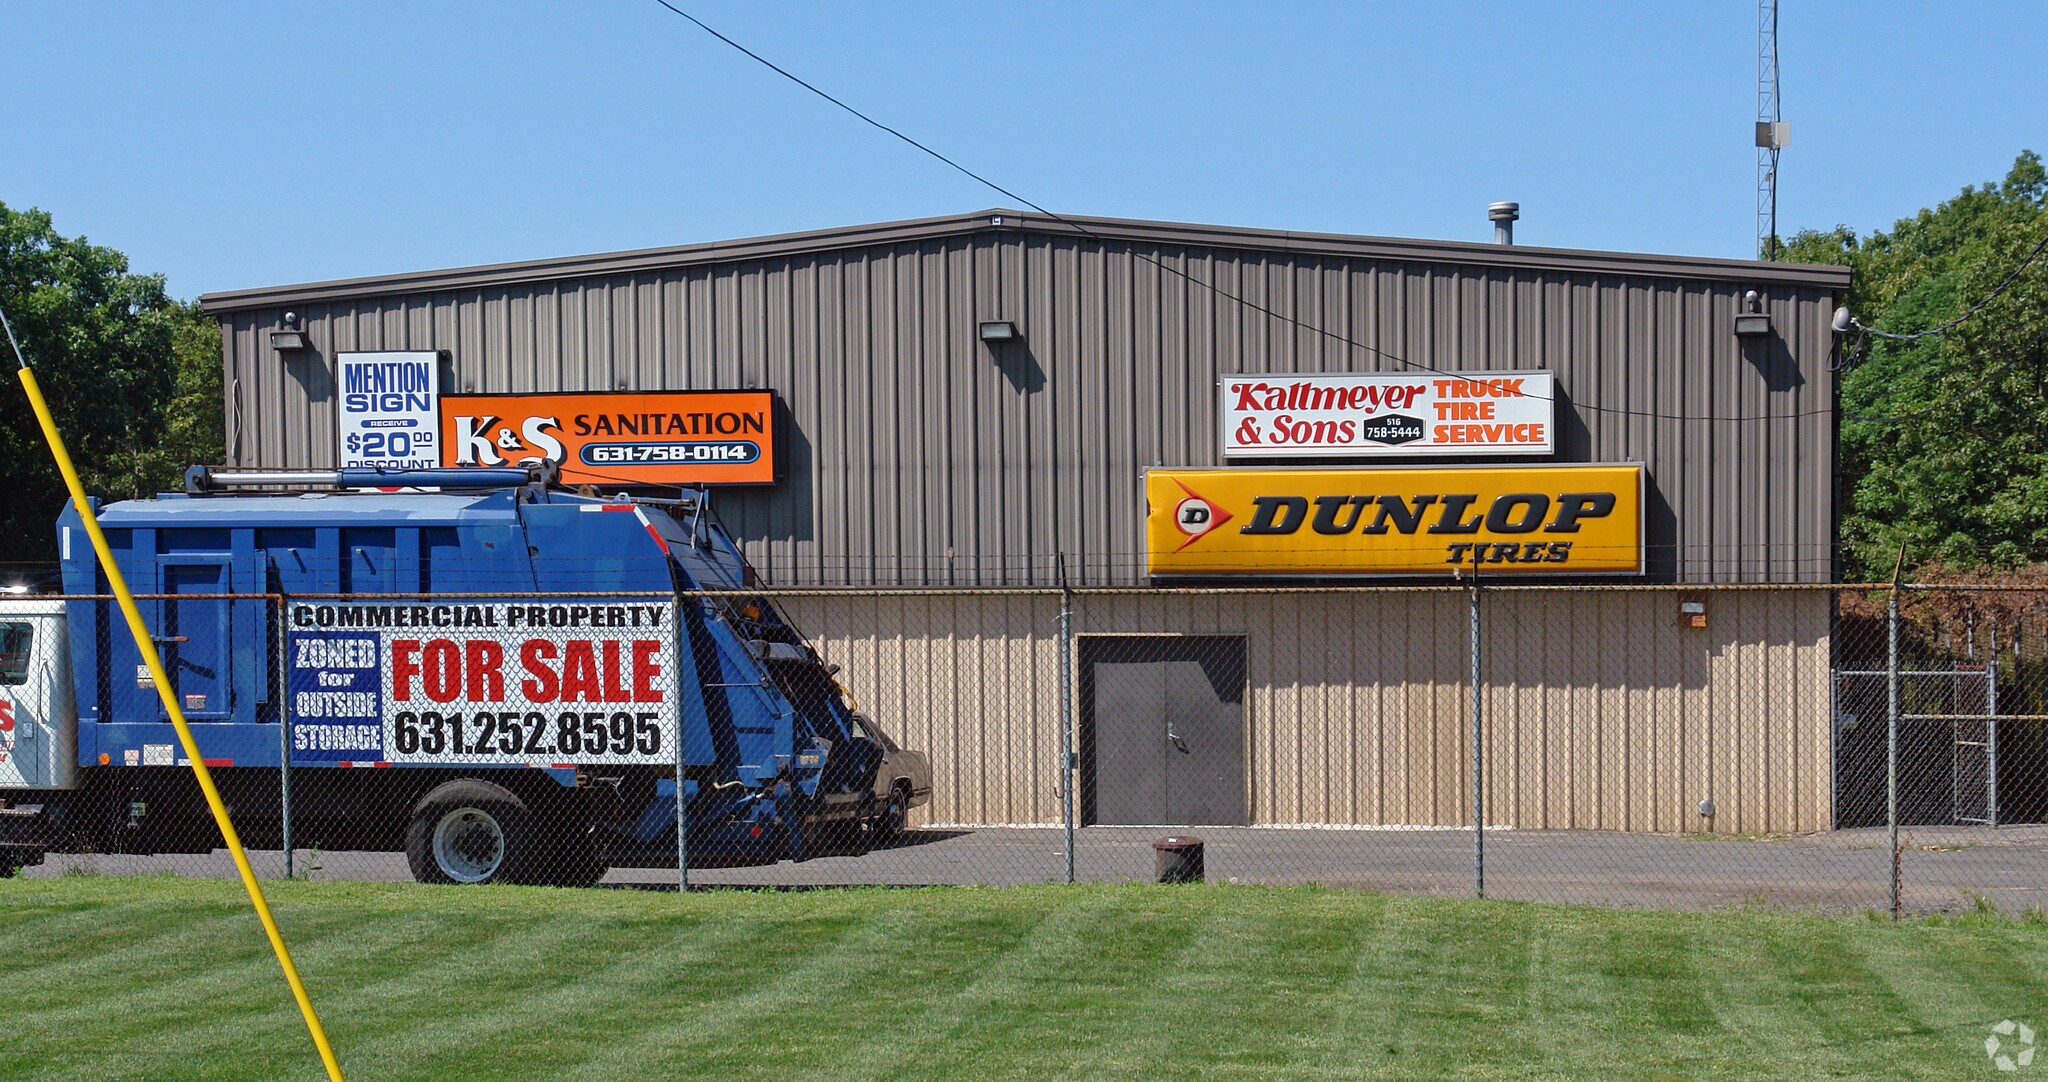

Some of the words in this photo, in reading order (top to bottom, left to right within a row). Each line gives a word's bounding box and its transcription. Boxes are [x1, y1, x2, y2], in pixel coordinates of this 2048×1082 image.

[344, 362, 429, 393] MENTION
[1432, 378, 1526, 398] TRUCK
[345, 393, 431, 412] SIGN
[1432, 401, 1496, 421] TIRE
[574, 412, 764, 436] SANITATION
[1235, 416, 1262, 445] &
[1269, 414, 1356, 444] Sons
[1367, 427, 1421, 438] 758-5444
[1386, 418, 1401, 426] 516
[1432, 423, 1545, 443] SERVICE
[592, 445, 748, 461] 631-758-0114
[1180, 506, 1209, 525] D
[1239, 493, 1617, 535] DUNLOP
[1446, 541, 1574, 564] TIRES
[293, 605, 498, 628] COMMERCIAL
[507, 605, 664, 628] PROPERTY
[295, 638, 376, 668] ZONED
[318, 671, 355, 687] for
[391, 638, 505, 703] FOR
[520, 638, 664, 703] SALE
[296, 691, 378, 717] OUTSIDE
[294, 724, 382, 750] STORAGE
[395, 711, 660, 756] 631.252.8595
